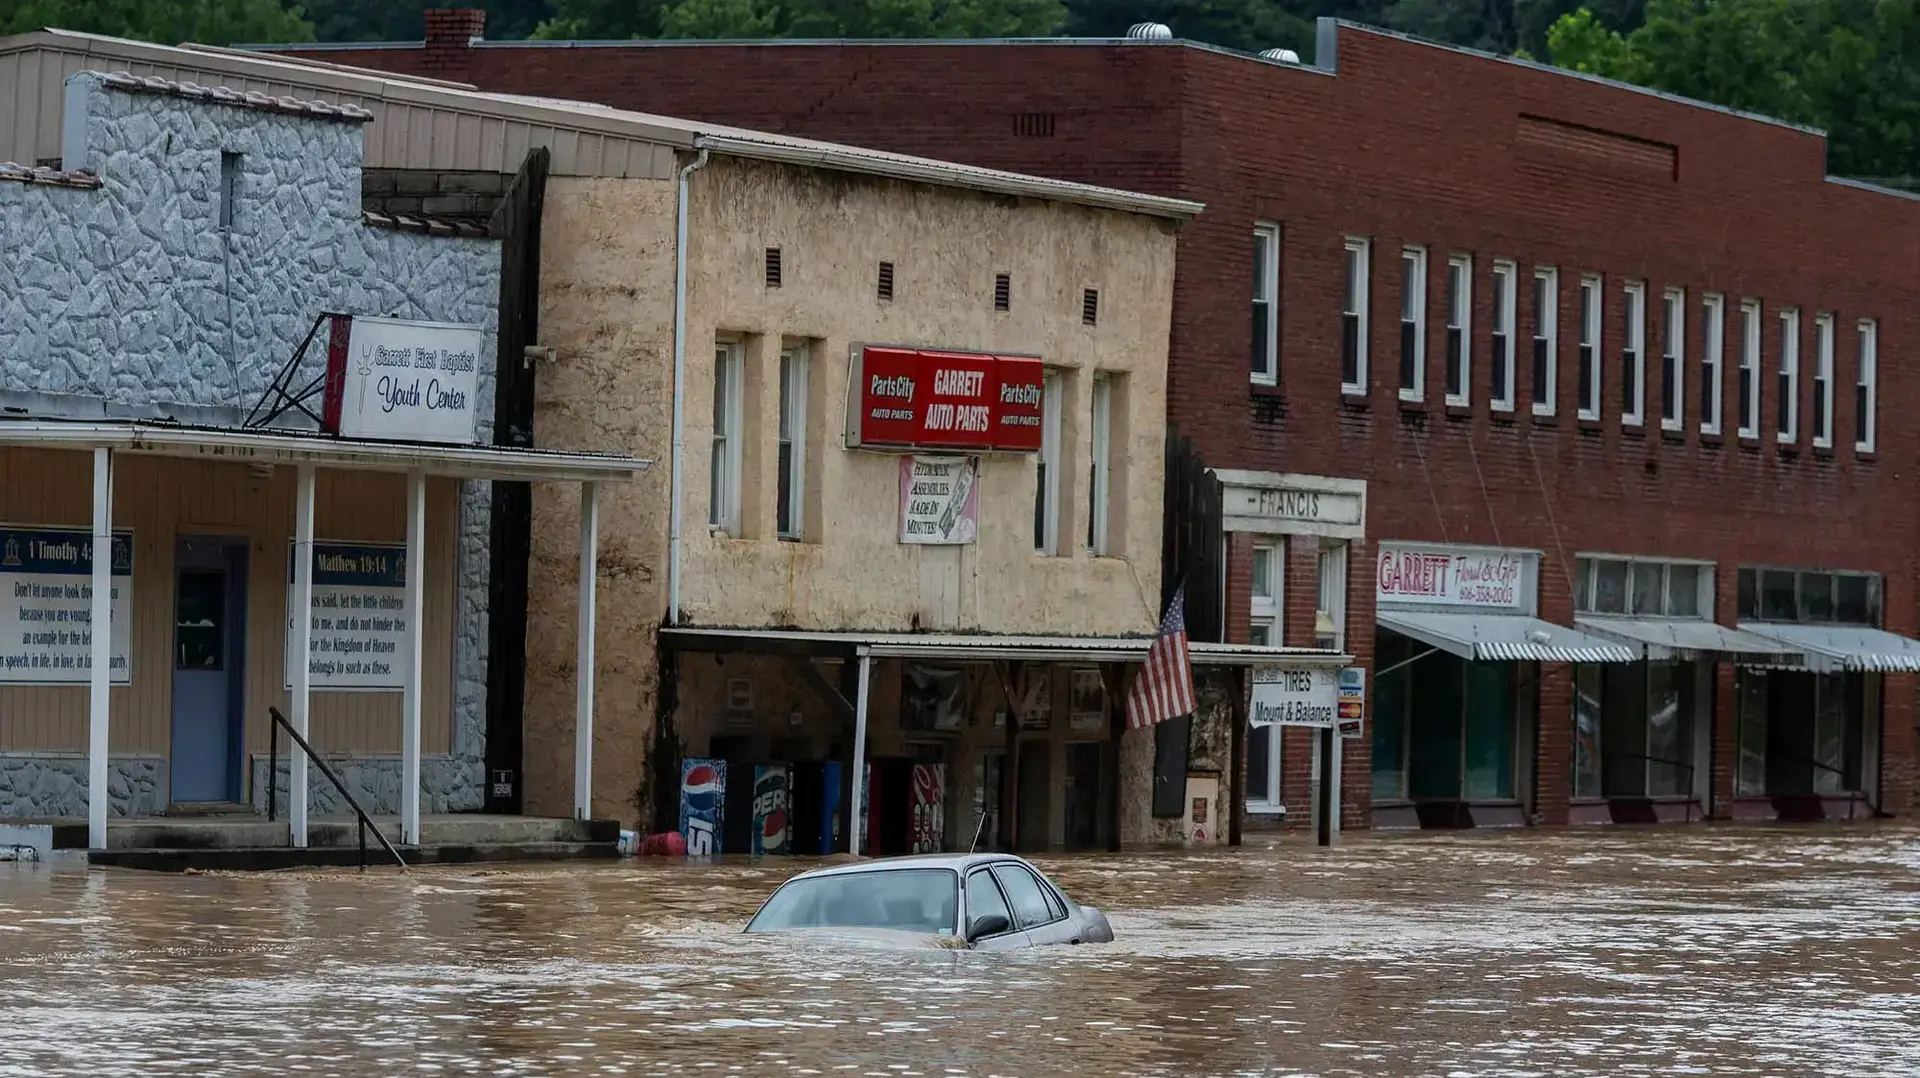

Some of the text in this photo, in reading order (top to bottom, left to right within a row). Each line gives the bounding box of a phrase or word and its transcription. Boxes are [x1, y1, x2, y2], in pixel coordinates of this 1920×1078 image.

[374, 345, 475, 375] Garrett First Baptist
[871, 374, 915, 403] PartsCity
[934, 368, 985, 397] GARRETT
[377, 375, 466, 413] Youth Center
[1000, 382, 1041, 410] PartsCity
[871, 408, 914, 420] AUTO PARTS
[924, 403, 990, 432] AUTO PARTS
[1001, 415, 1040, 427] AUTO PARTS
[1259, 490, 1319, 518] FRANCIS
[28, 540, 92, 565] 1 Timothy 4:
[318, 554, 387, 574] Matthew 19:14
[1481, 558, 1492, 582] &
[1379, 552, 1450, 597] GARRETT
[64, 583, 80, 599] look
[80, 584, 93, 599] dow
[110, 587, 119, 600] ou
[321, 593, 339, 611] said,
[340, 593, 349, 609] let
[350, 593, 362, 609] the
[363, 593, 378, 609] little
[19, 605, 44, 622] because
[44, 609, 56, 624] you
[57, 609, 69, 621] are
[311, 616, 320, 630] to
[320, 618, 335, 632] me,
[335, 616, 348, 630] and
[349, 616, 359, 631] do
[360, 618, 372, 631] not
[372, 616, 393, 632] hinder
[22, 632, 31, 645] an
[32, 630, 57, 648] example
[58, 630, 69, 646] for
[70, 630, 80, 645] the
[320, 637, 332, 652] the
[332, 637, 363, 656] Kingdom
[364, 638, 373, 653] of
[372, 638, 396, 654] Heaven
[5, 652, 30, 672] speech,
[31, 652, 39, 669] in
[53, 652, 60, 669] in
[309, 659, 392, 677] belongs to such as these.
[1283, 670, 1312, 692] TIRES
[1255, 701, 1332, 722] Mount & Balance
